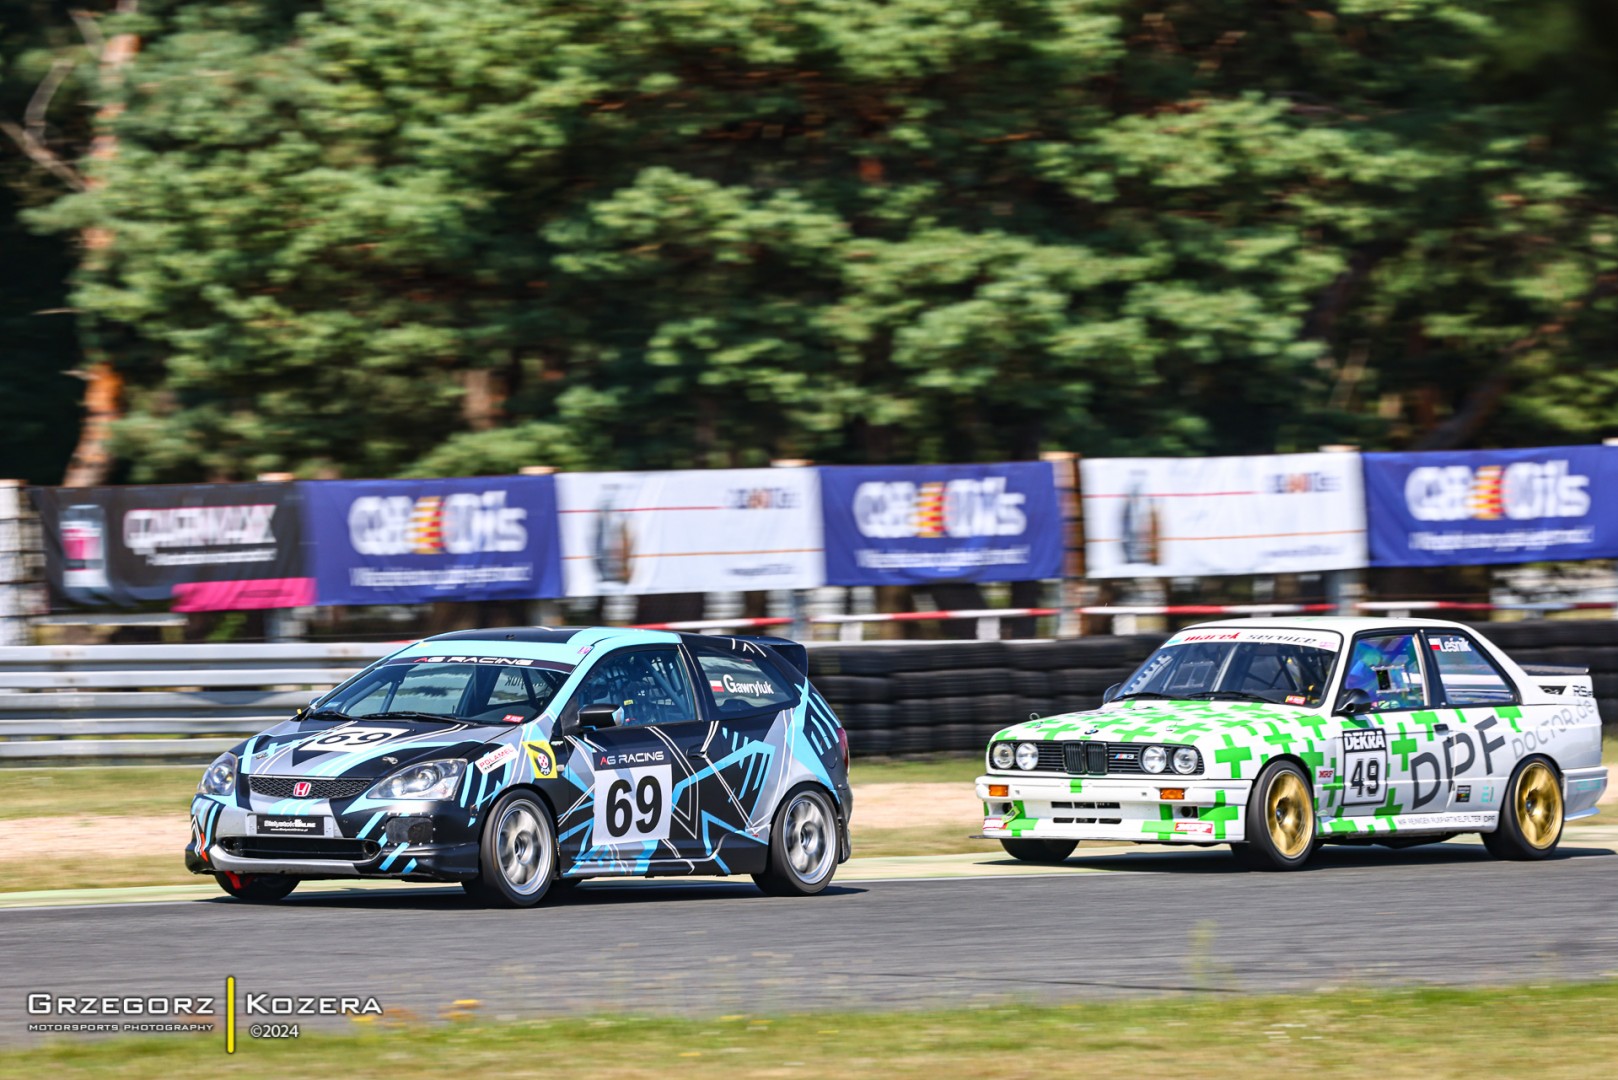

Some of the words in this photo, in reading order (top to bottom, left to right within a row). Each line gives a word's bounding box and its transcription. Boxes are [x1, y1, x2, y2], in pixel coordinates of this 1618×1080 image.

[447, 656, 533, 666] RACING
[723, 674, 774, 697] Gawryluk
[317, 731, 392, 746] 69
[1343, 731, 1386, 751] DEKRA
[479, 746, 514, 768] POLAMEL
[600, 756, 616, 766] AG
[618, 751, 664, 764] RACING
[1410, 715, 1506, 810] DPF
[1511, 698, 1594, 760] DOCTOR.de
[1350, 758, 1379, 798] 49
[606, 775, 662, 838] 69
